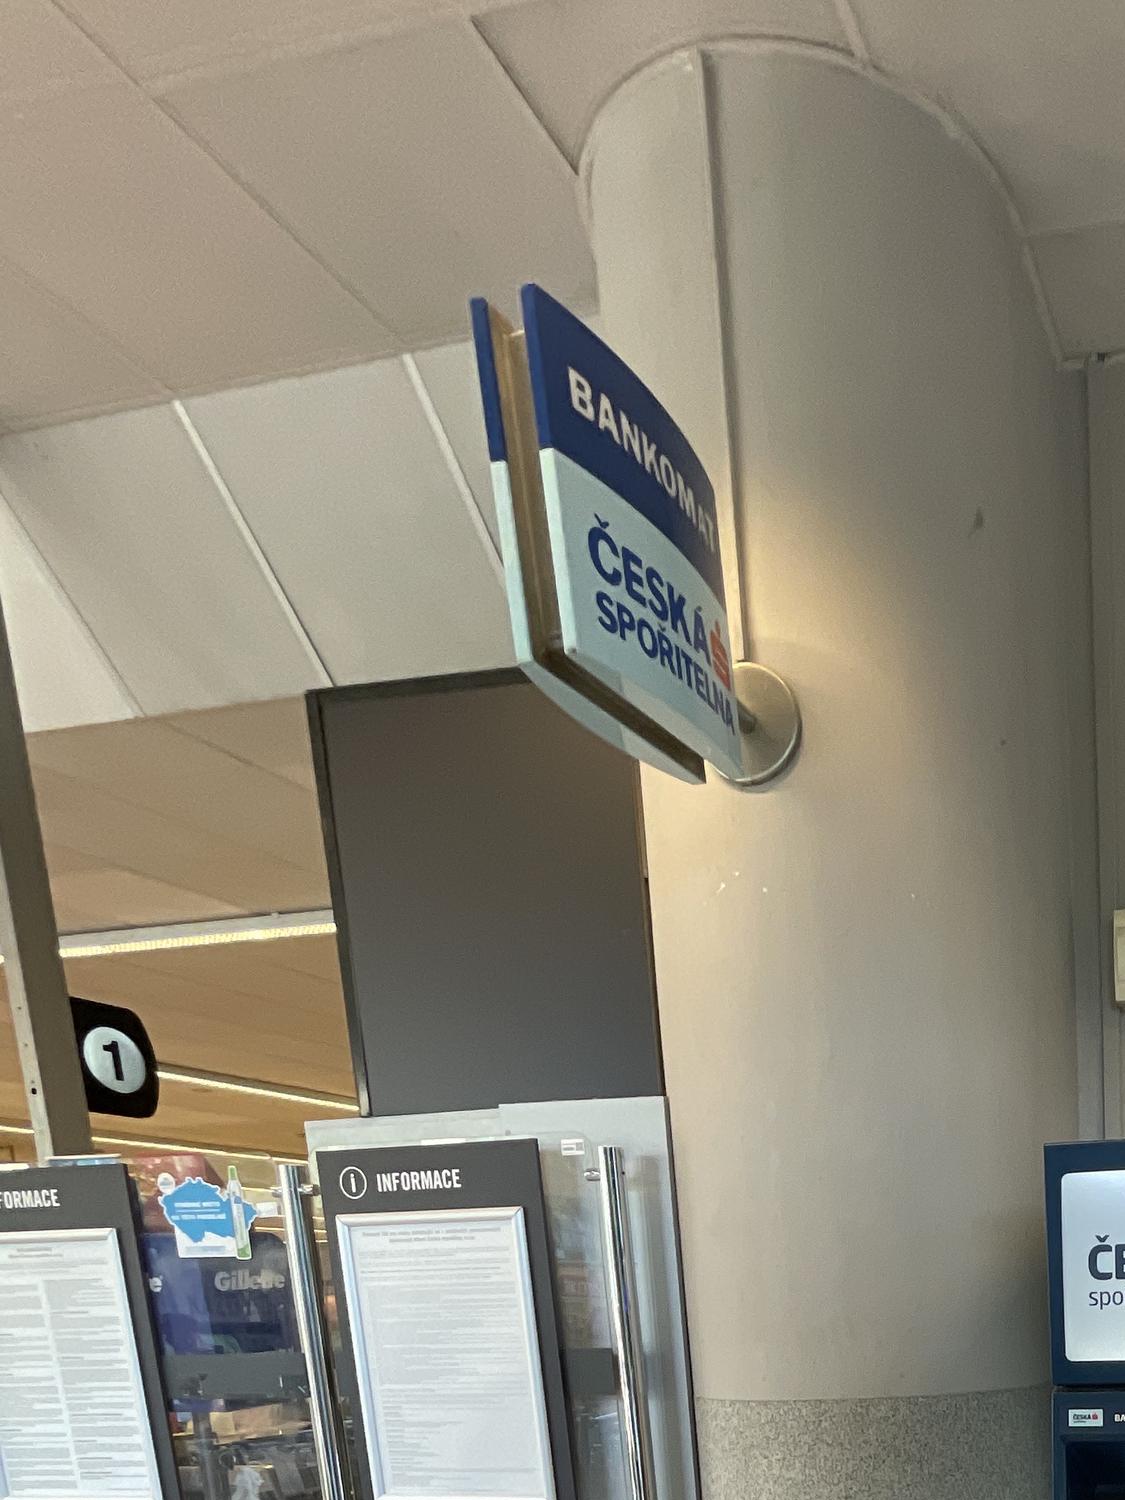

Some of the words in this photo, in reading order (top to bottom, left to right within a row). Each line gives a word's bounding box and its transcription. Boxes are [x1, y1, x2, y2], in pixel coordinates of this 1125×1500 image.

[567, 365, 715, 553] BANKOMAT
[588, 512, 712, 667] ČESKÁ
[596, 590, 736, 736] SPOŘITELNA
[102, 1039, 126, 1083] 1
[376, 1168, 462, 1193] INFORMACE
[214, 1269, 286, 1292] Gillette
